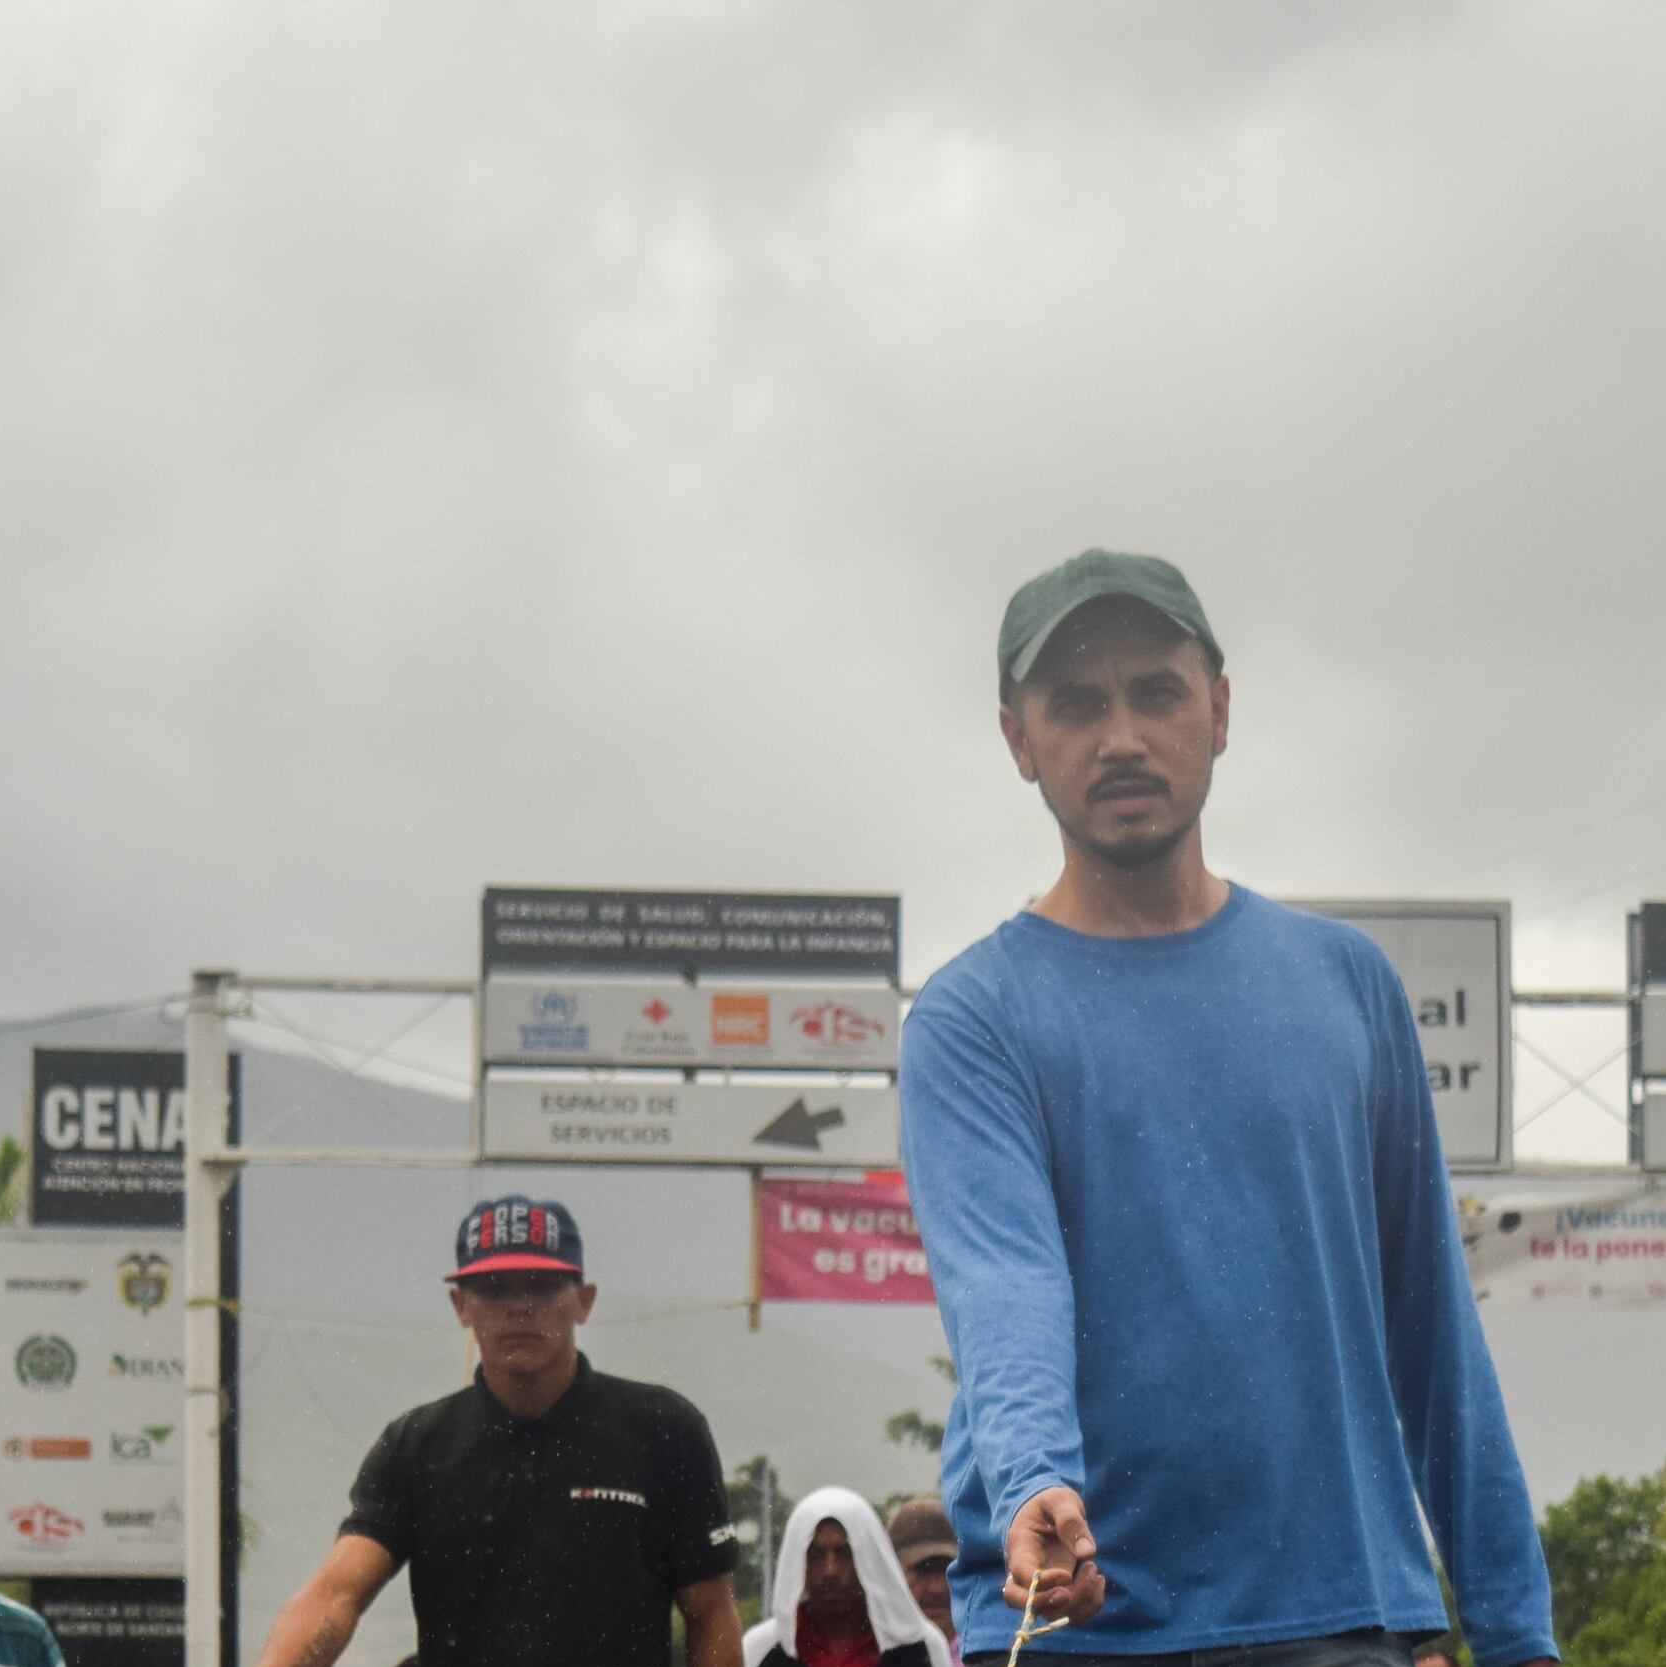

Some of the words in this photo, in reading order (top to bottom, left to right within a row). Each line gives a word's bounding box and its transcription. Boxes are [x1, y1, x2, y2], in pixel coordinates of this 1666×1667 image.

[599, 905, 625, 923] DE
[724, 932, 774, 950] PARA
[777, 934, 803, 950] LA
[540, 1091, 639, 1115] ESPACIO
[646, 1093, 679, 1116] DE
[549, 1123, 672, 1146] SERVICIOS
[780, 1201, 823, 1233] La
[1530, 1236, 1555, 1260] te
[1563, 1234, 1589, 1260] la
[813, 1248, 858, 1275] es
